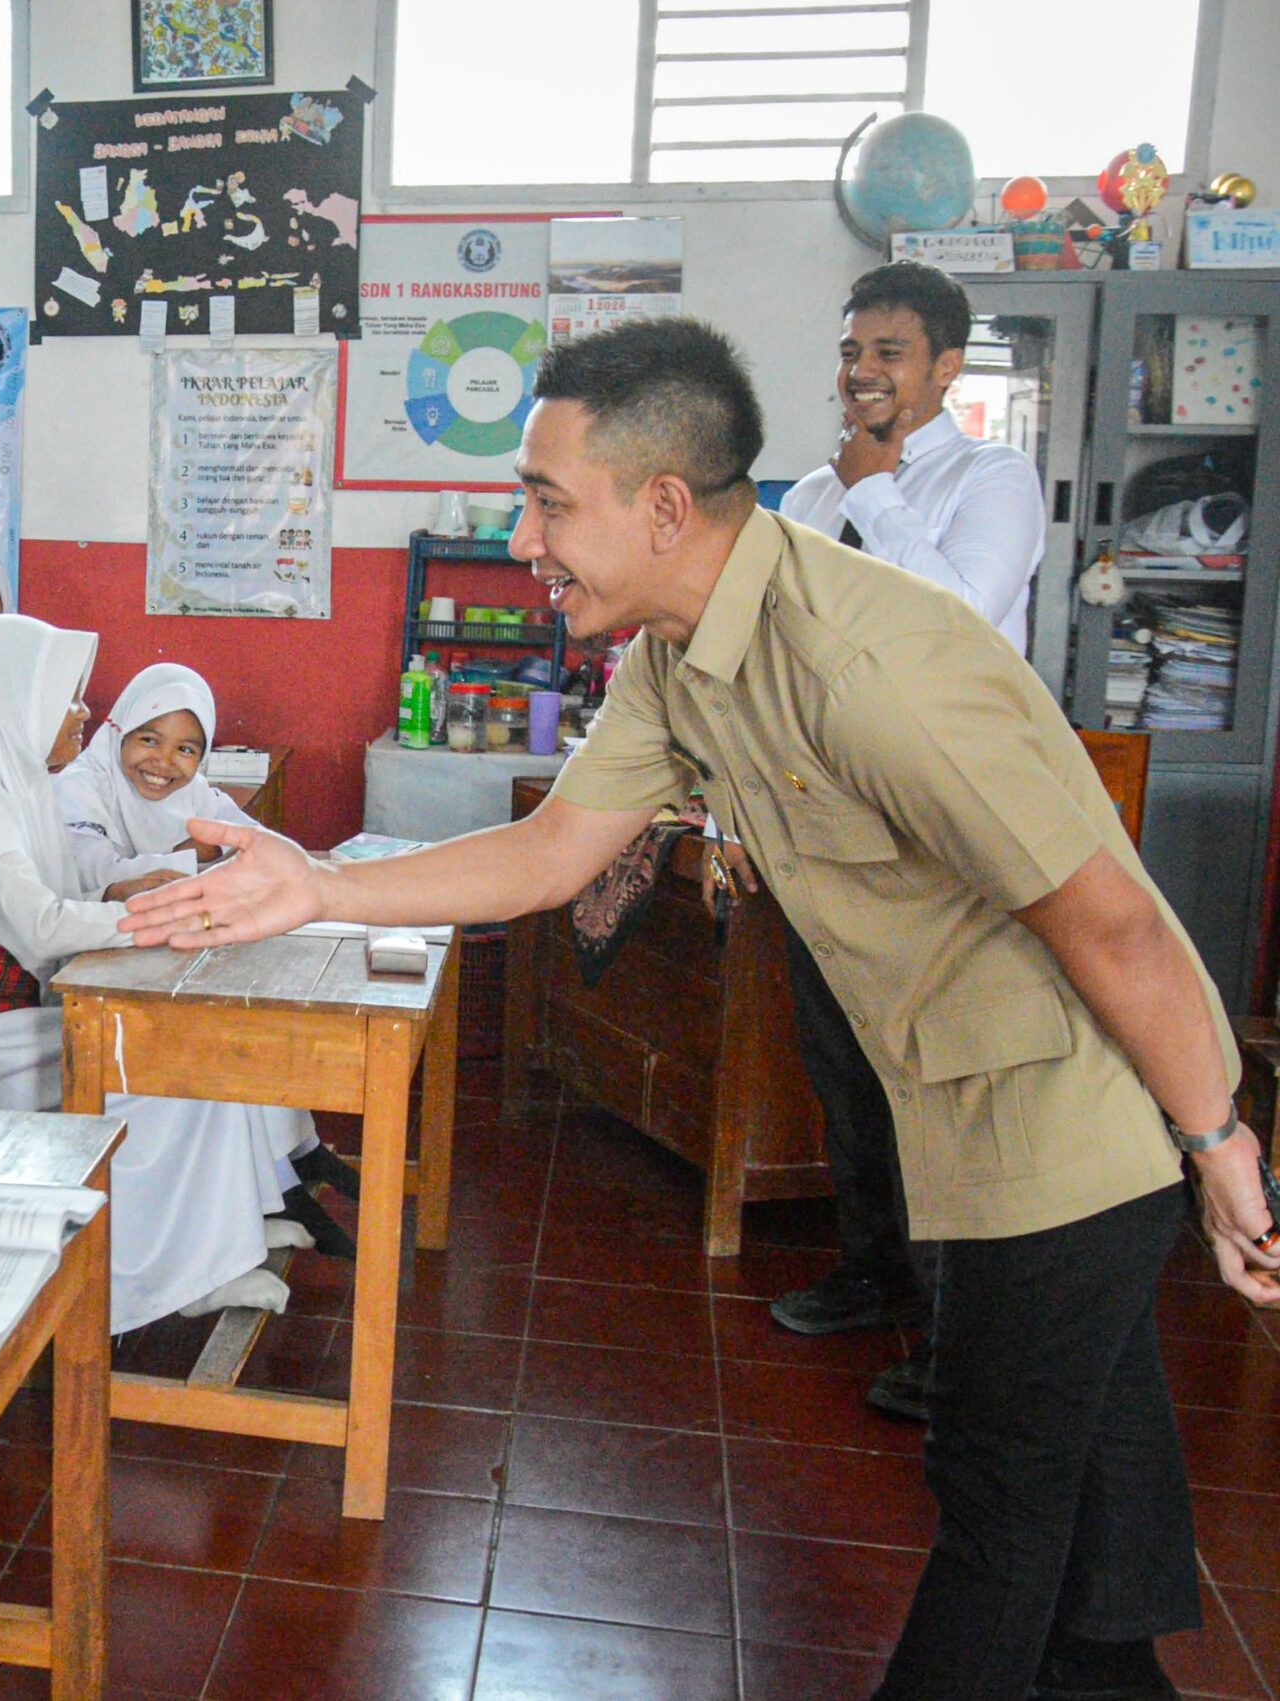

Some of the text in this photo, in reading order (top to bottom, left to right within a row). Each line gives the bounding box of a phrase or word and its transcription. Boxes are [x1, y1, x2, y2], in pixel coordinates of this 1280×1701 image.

[361, 282, 541, 298] SDN 1 RANGKASBITUNG
[180, 377, 309, 392] IKRAR PELAJAR
[197, 393, 288, 407] INDONESIA
[184, 434, 188, 445] 1
[181, 466, 189, 477] 2
[181, 498, 188, 510] 3
[179, 530, 187, 542] 4
[178, 562, 186, 574] 5
